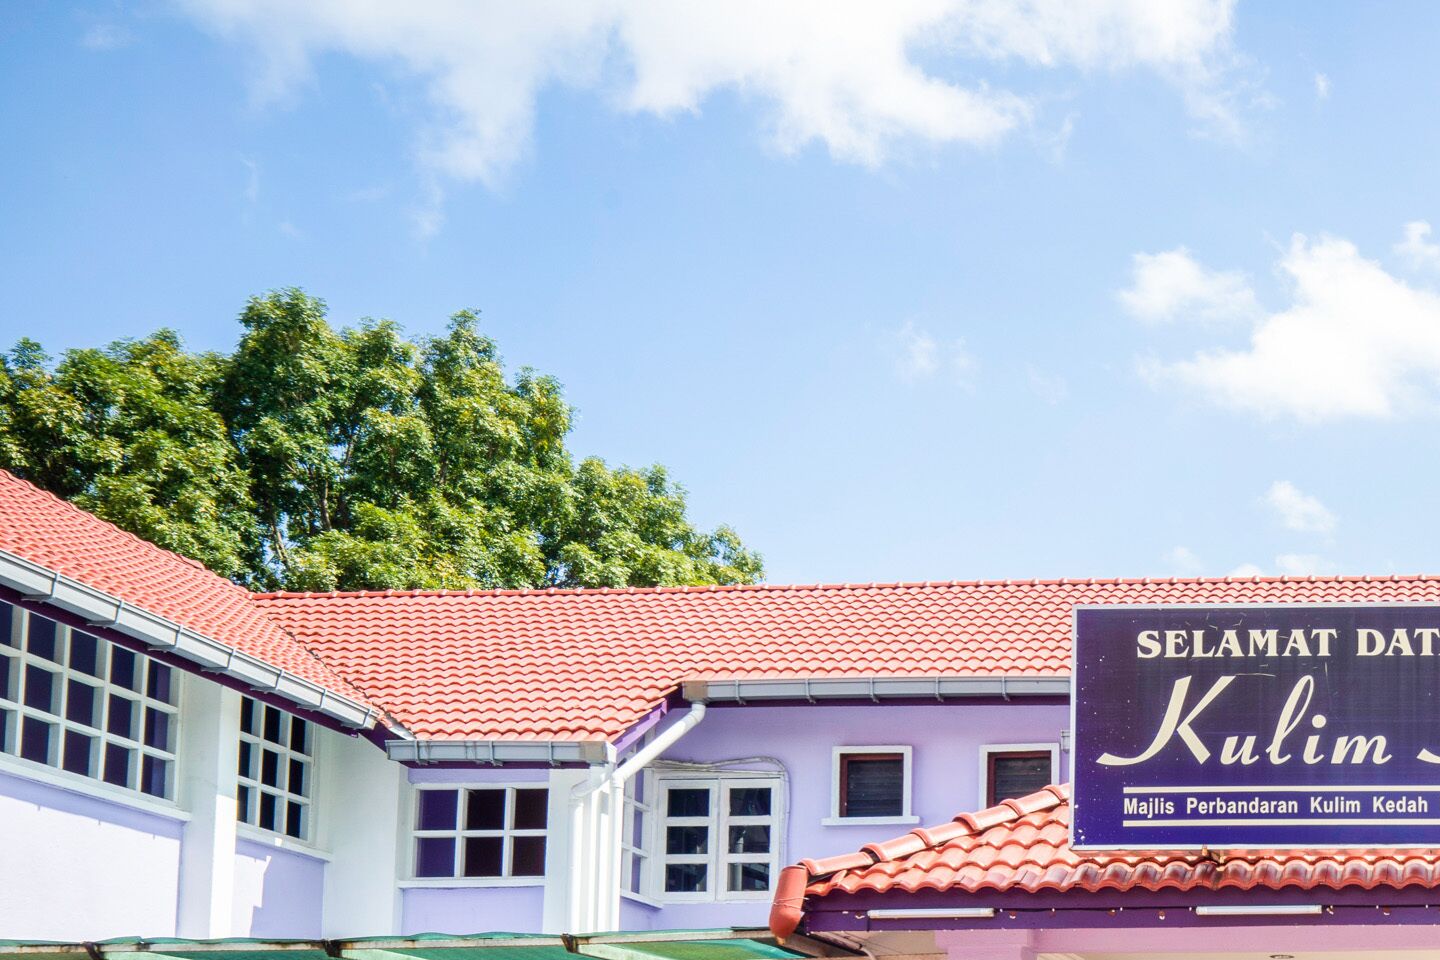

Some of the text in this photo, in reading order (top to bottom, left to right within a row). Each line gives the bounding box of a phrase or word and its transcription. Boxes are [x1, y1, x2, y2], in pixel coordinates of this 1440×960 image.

[1136, 628, 1338, 658] SELAMAT
[1095, 674, 1393, 766] Kulim
[1123, 797, 1175, 818] Majlis
[1186, 796, 1298, 815] Perbandaran
[1309, 796, 1361, 814] Kulim
[1372, 795, 1428, 813] Kedah
